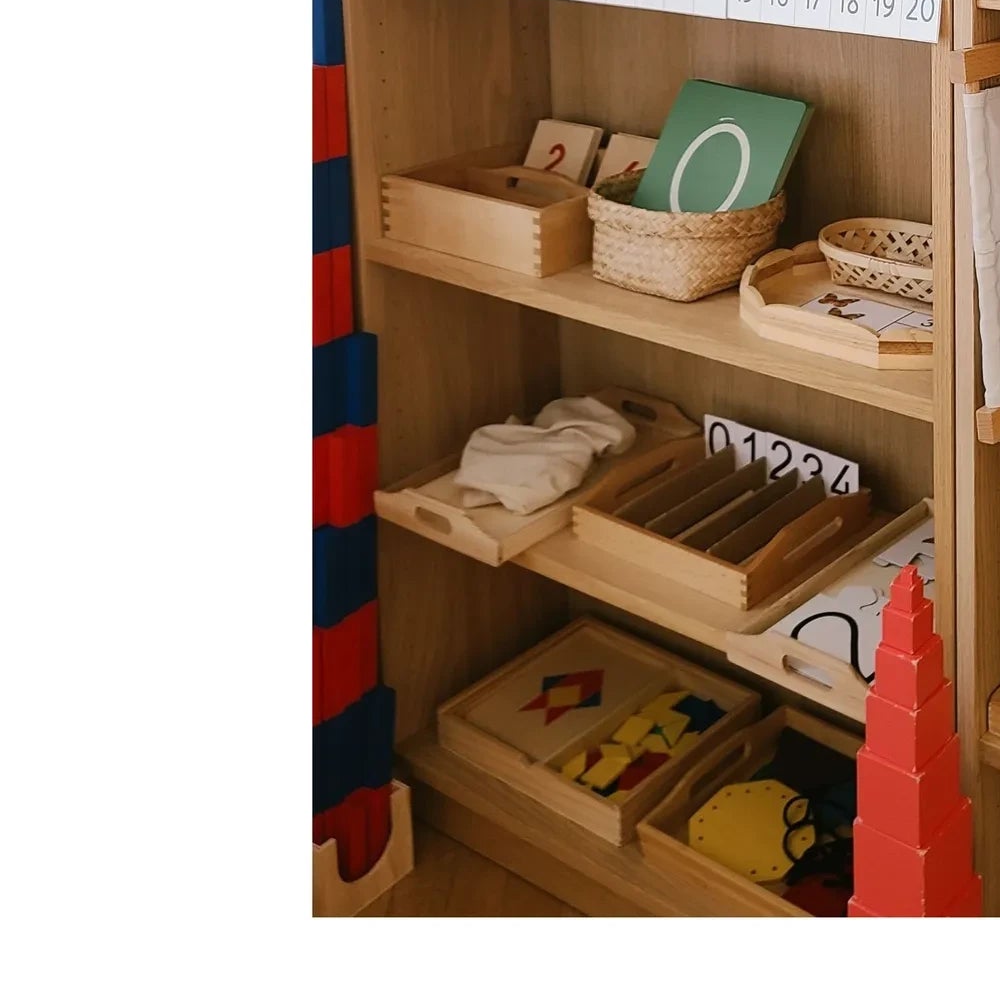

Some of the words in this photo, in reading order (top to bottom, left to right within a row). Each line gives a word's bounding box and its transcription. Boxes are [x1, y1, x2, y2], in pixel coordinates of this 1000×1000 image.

[543, 143, 566, 171] 2
[709, 421, 731, 455] 0
[743, 432, 756, 463] 1
[769, 440, 792, 480] 2
[830, 464, 850, 495] 4
